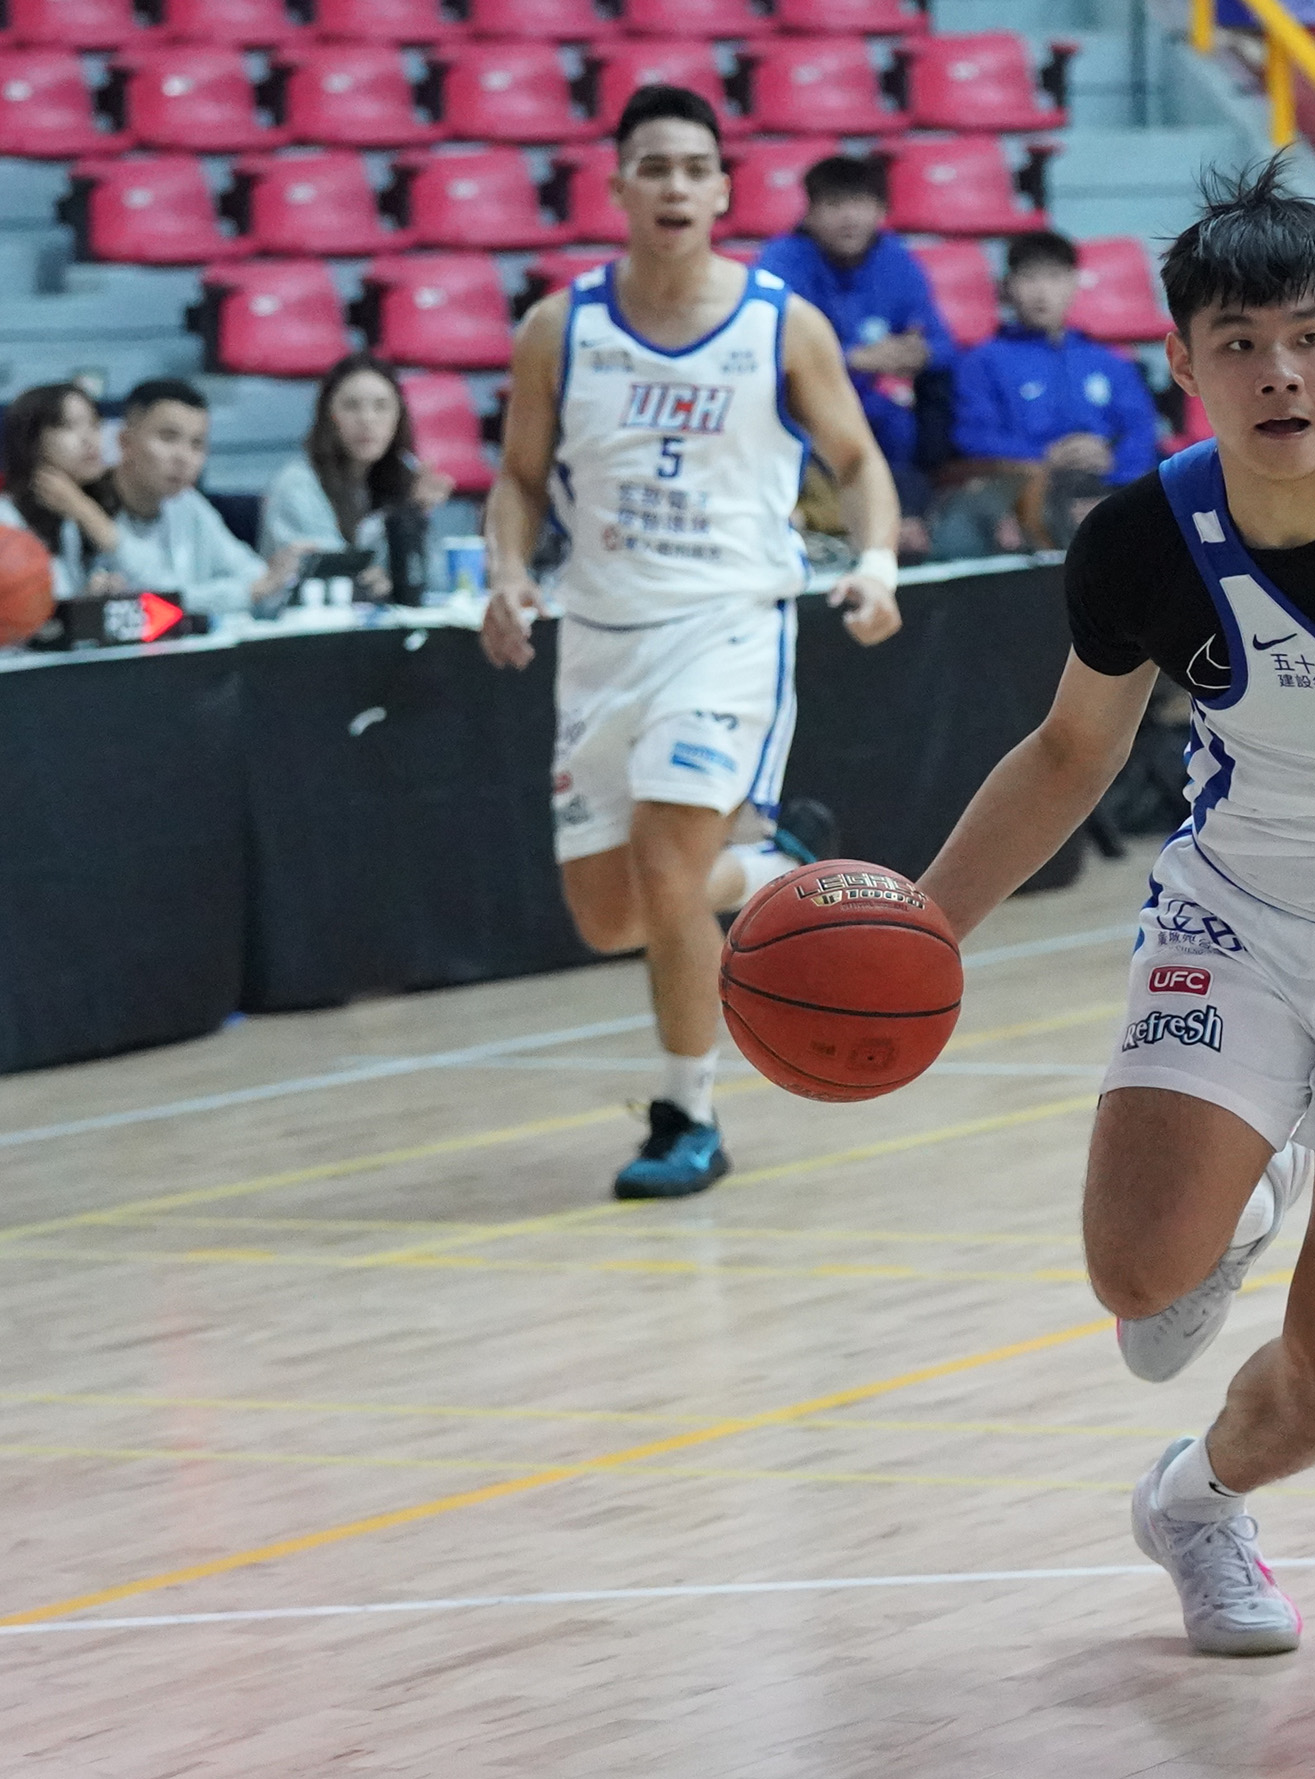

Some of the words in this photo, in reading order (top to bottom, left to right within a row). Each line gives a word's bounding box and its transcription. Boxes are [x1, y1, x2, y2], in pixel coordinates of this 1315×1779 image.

[622, 383, 733, 434] UCH
[657, 436, 684, 478] 5
[1153, 971, 1205, 989] UFC
